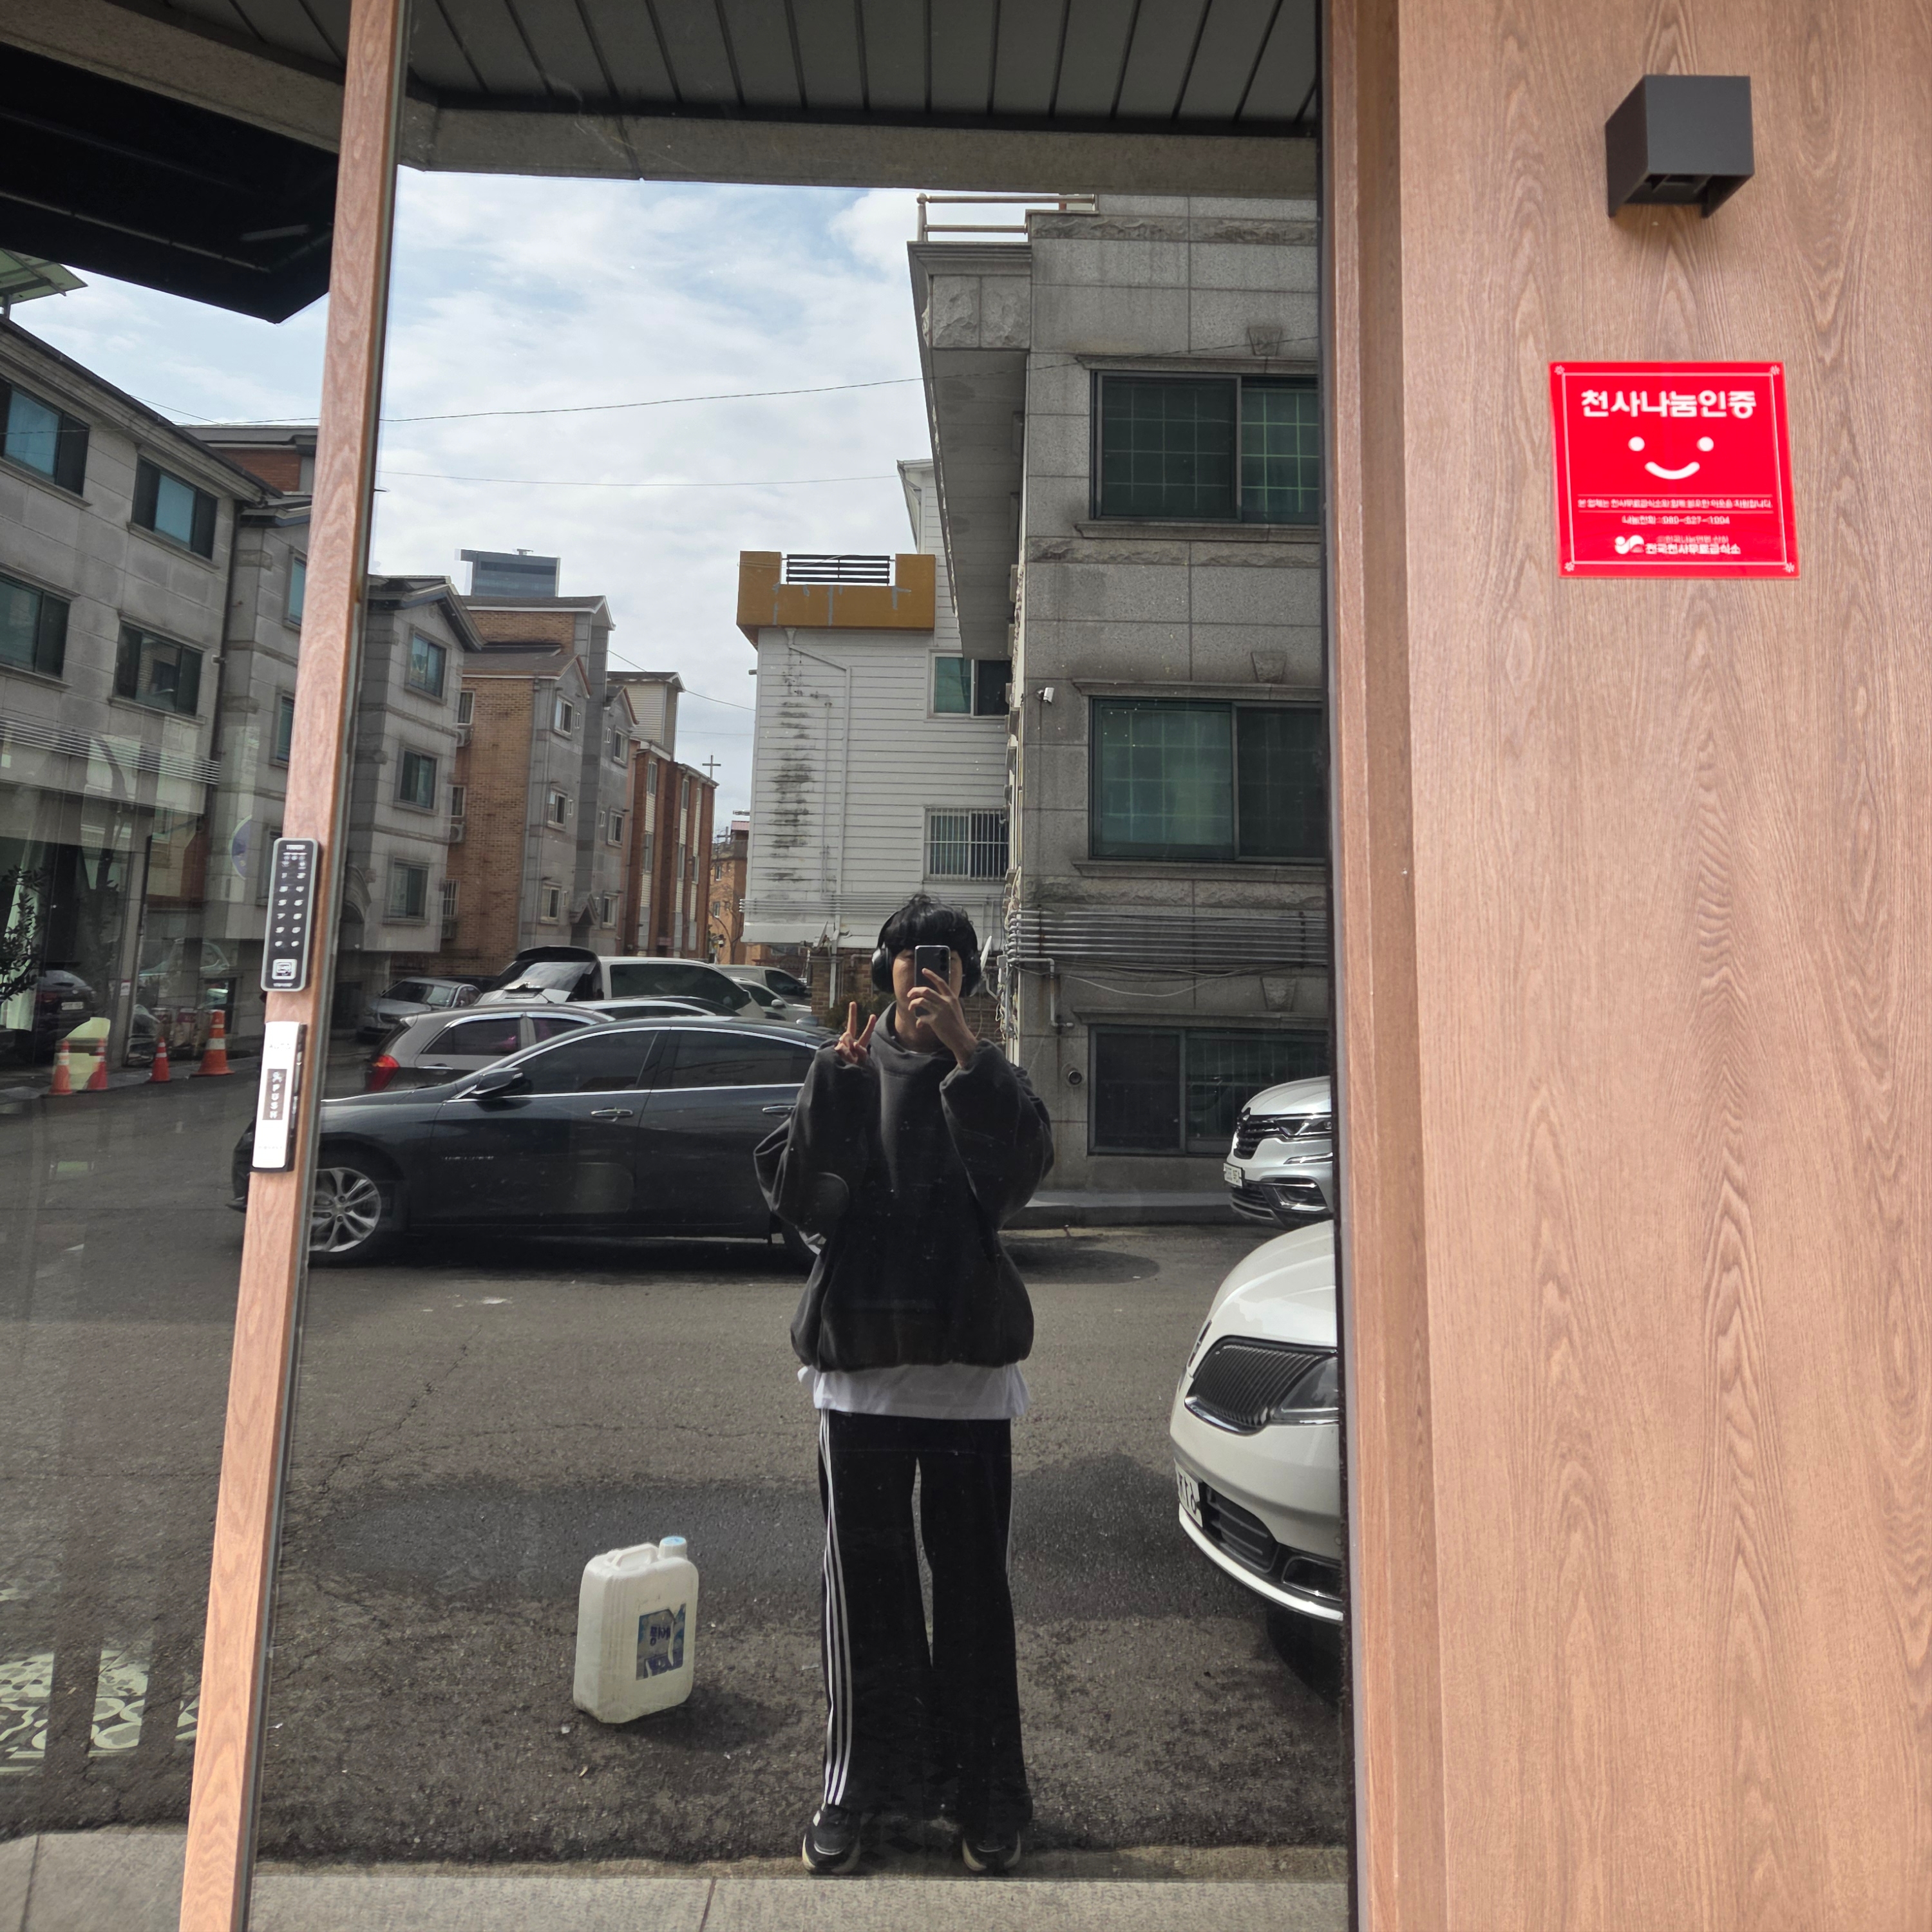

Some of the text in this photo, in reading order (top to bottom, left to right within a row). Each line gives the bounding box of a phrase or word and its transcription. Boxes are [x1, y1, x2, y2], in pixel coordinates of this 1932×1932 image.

[1581, 390, 1756, 419] 천사나눔인증
[1645, 543, 1741, 555] 전국천사무료급식소
[269, 1083, 280, 1119] PUSH
